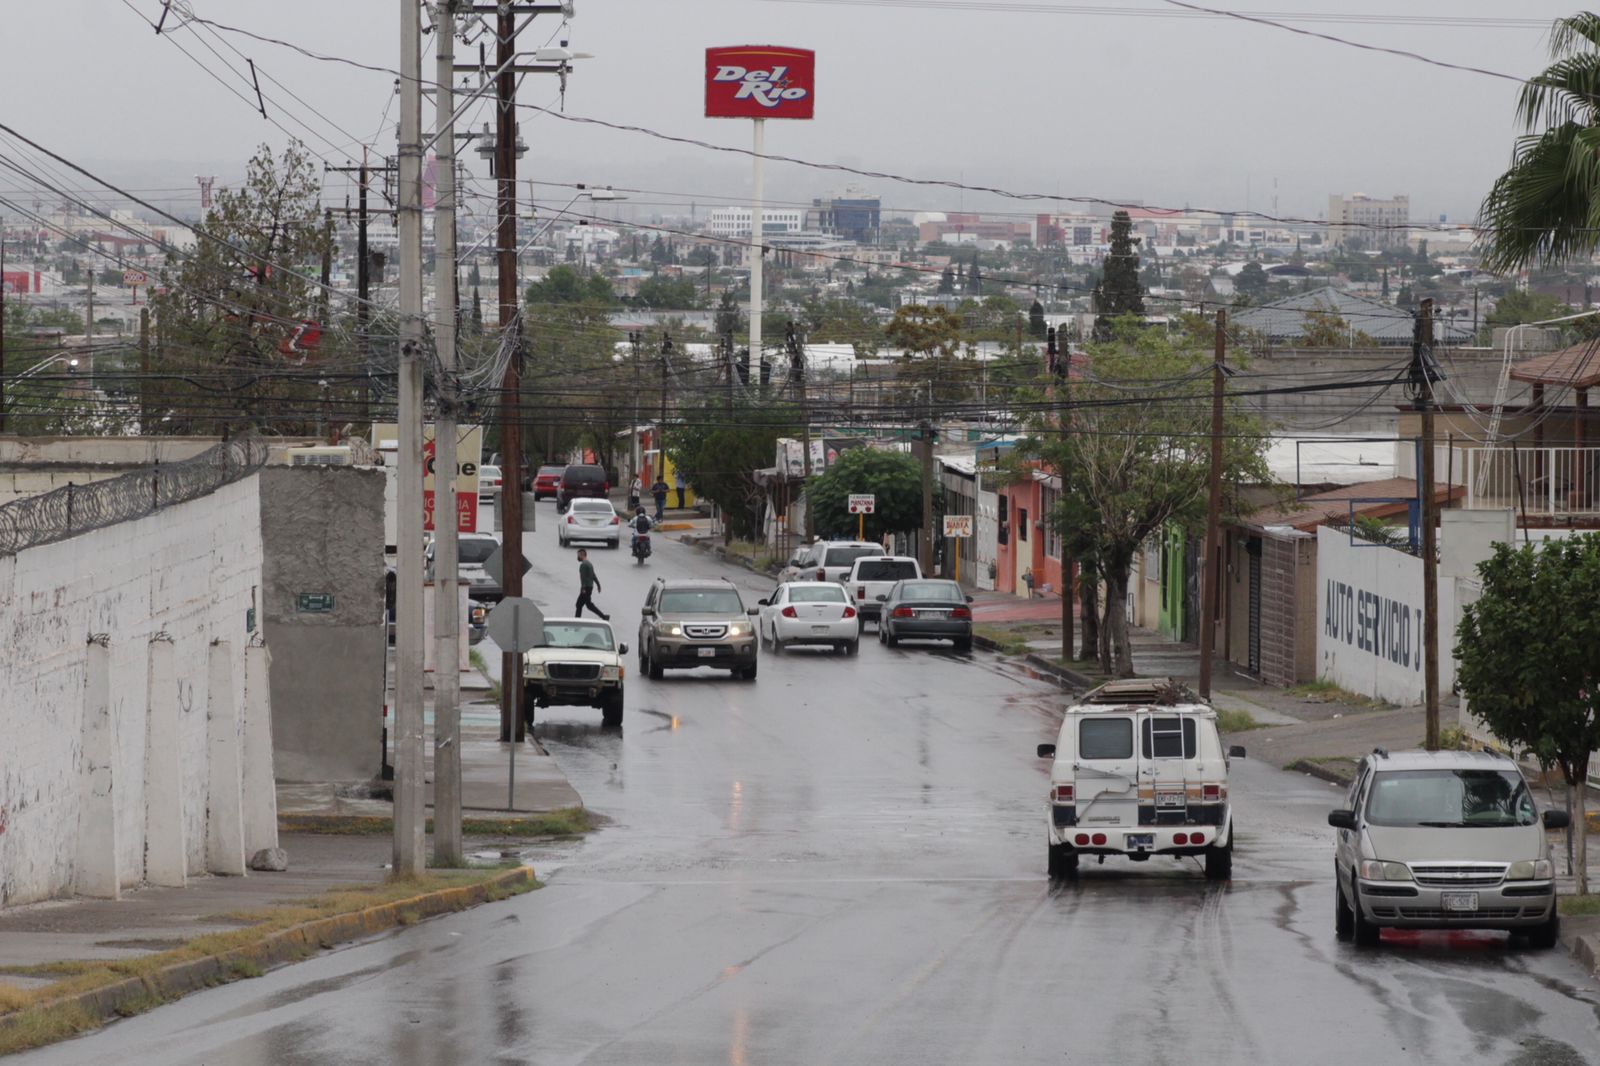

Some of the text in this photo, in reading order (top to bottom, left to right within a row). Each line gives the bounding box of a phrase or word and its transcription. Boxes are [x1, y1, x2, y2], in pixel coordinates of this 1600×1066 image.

[713, 65, 788, 82] Del
[734, 81, 807, 108] Rio
[1325, 579, 1354, 646] AUTO
[1357, 589, 1410, 668] SERVICIO
